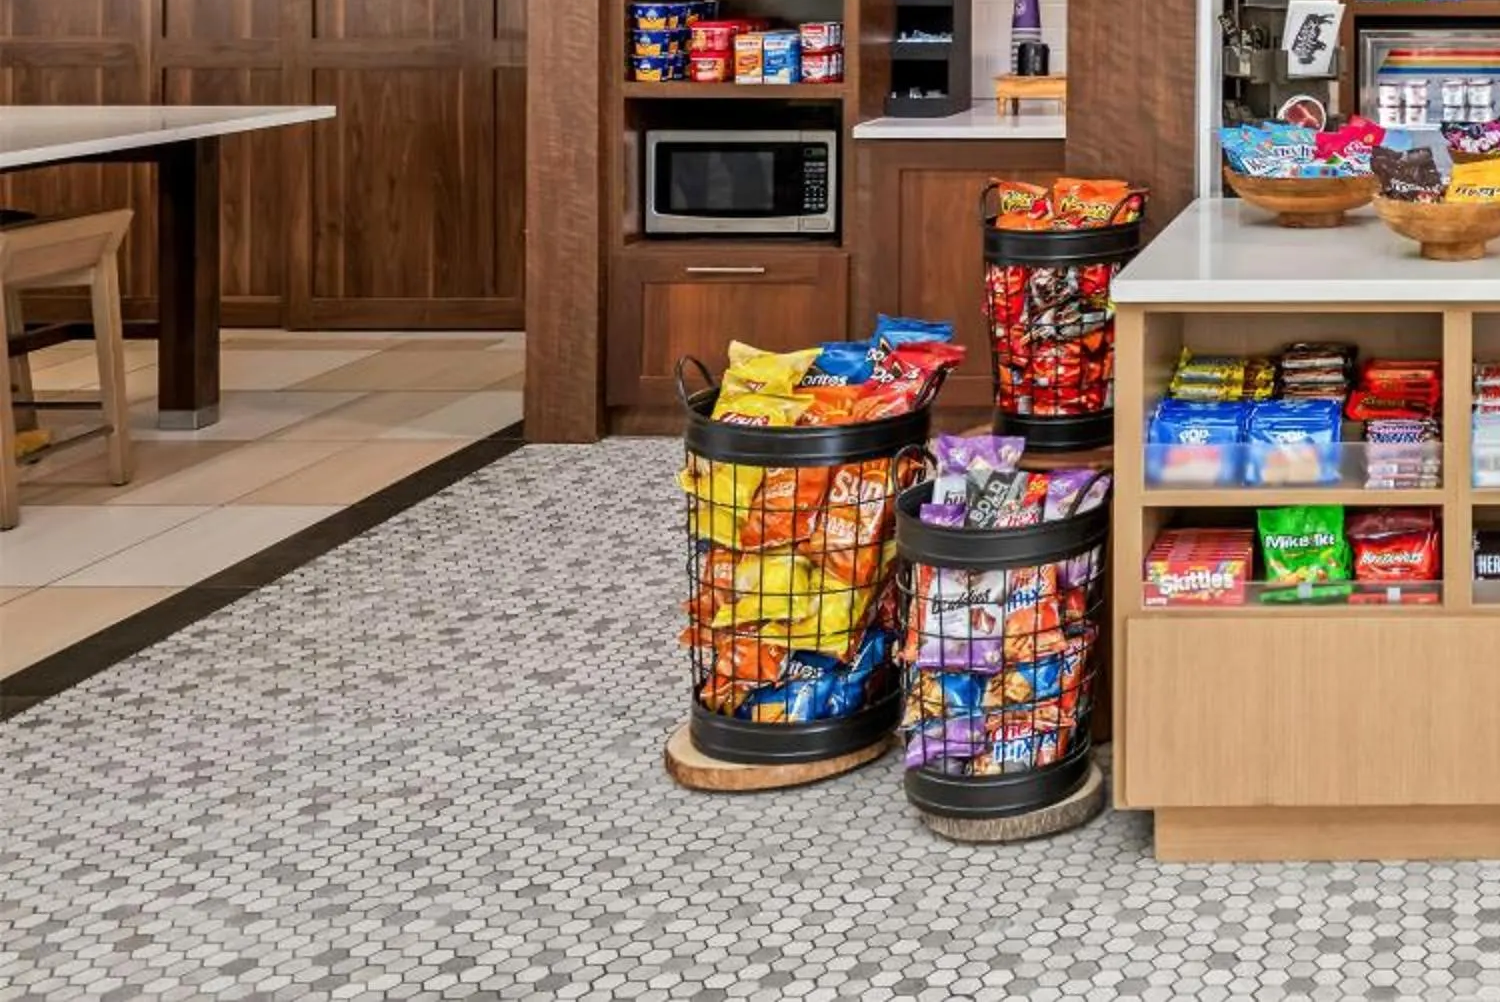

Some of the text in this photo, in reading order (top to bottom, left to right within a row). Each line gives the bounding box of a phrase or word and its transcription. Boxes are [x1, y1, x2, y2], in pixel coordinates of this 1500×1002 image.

[801, 374, 850, 387] oritos
[827, 469, 886, 506] Sun
[1159, 568, 1236, 596] Skittles
